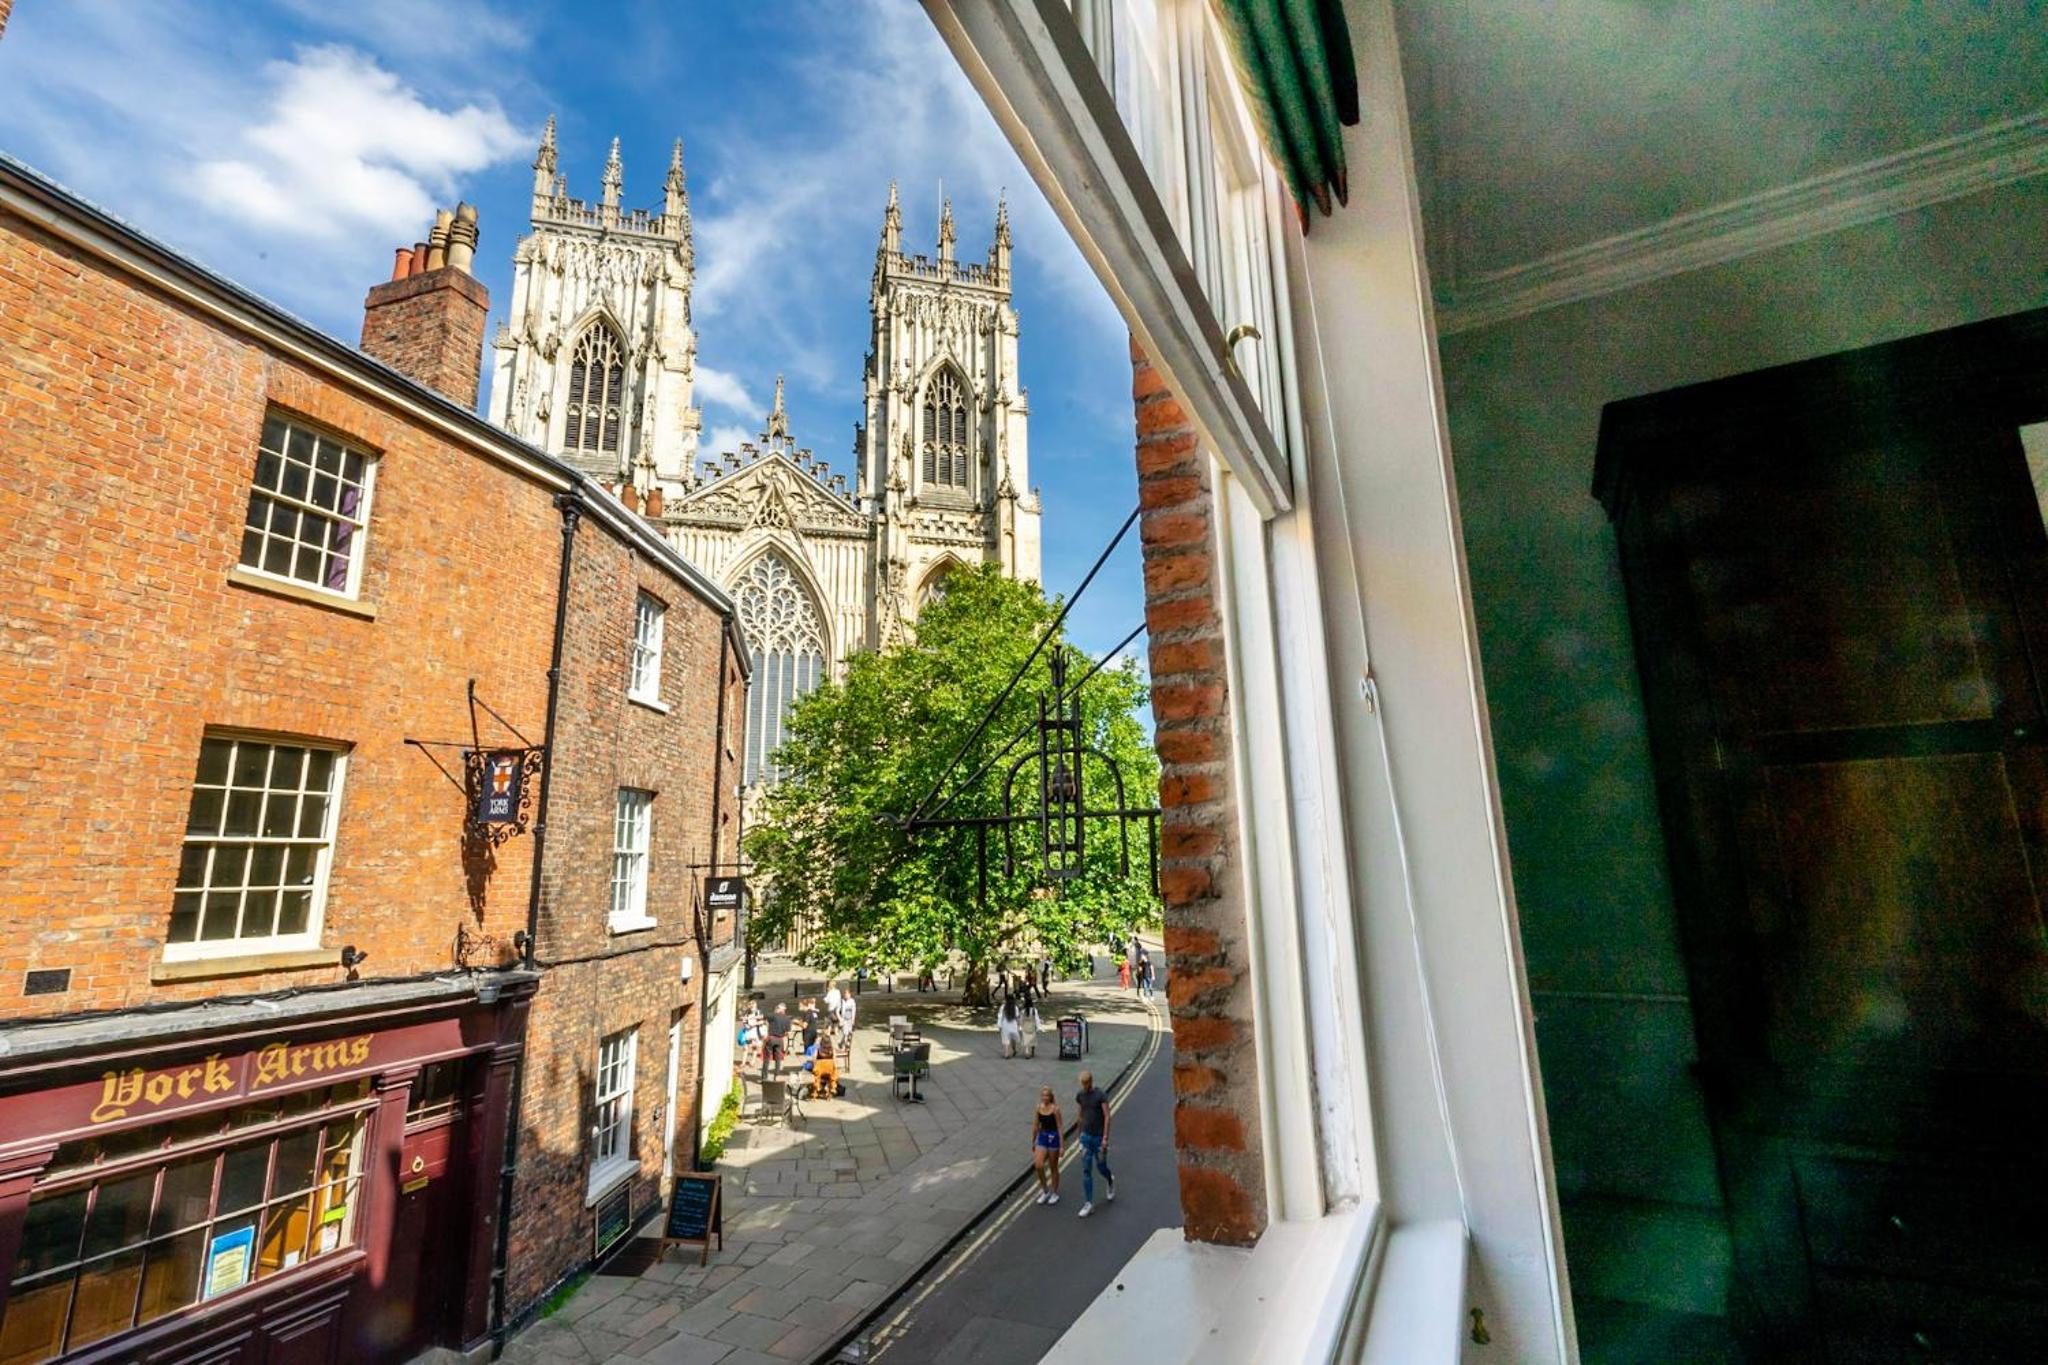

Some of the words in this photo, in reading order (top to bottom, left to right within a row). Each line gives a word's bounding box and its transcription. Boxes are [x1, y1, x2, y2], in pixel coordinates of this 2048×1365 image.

[490, 798, 509, 807] YORK
[489, 806, 509, 815] ARMS
[90, 1052, 235, 1123] York
[253, 1033, 374, 1089] Arms
